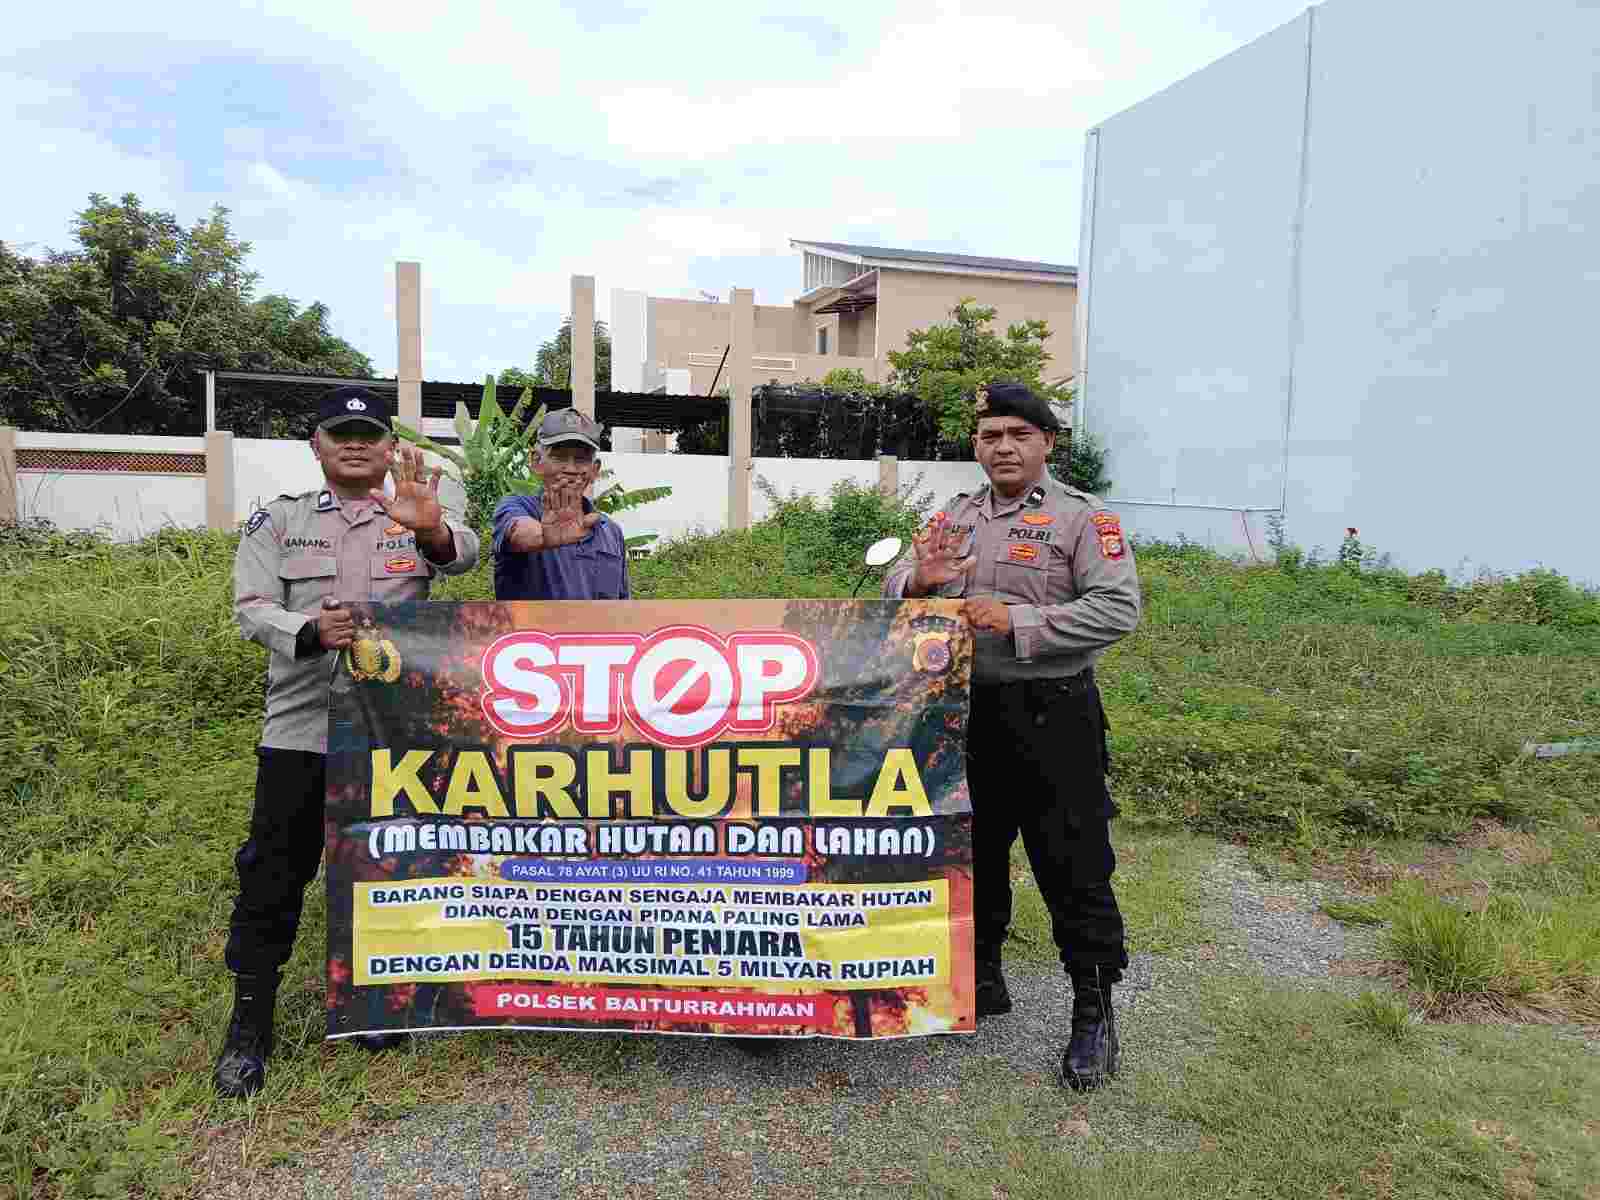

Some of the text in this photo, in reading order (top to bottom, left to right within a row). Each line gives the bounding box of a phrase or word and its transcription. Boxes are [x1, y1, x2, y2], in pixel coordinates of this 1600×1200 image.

[376, 537, 416, 551] POLR
[1008, 527, 1050, 543] POLRI
[490, 636, 809, 739] STOP
[370, 748, 933, 817] KARHUTLA
[368, 824, 936, 858] (MEMBAKAR HUTAN DAN LAHAN)
[512, 865, 794, 879] PASAL 78 AYAT (3) UU RI NO. 41 TAHUN 1999
[372, 886, 932, 907] BARANG SIAPA DENGAN SENGAJA MEMBAKAR HUTAN
[445, 905, 866, 927] DIANCAM DENGAN PIDANA PALING LAMA
[507, 923, 803, 957] 15 TAHUN PENJARA
[370, 952, 935, 980] DENGAN DENDA MAKSIMAL 5 MILYAR RUPIAH
[496, 992, 815, 1017] POLSEK BAITURRAHMAN
